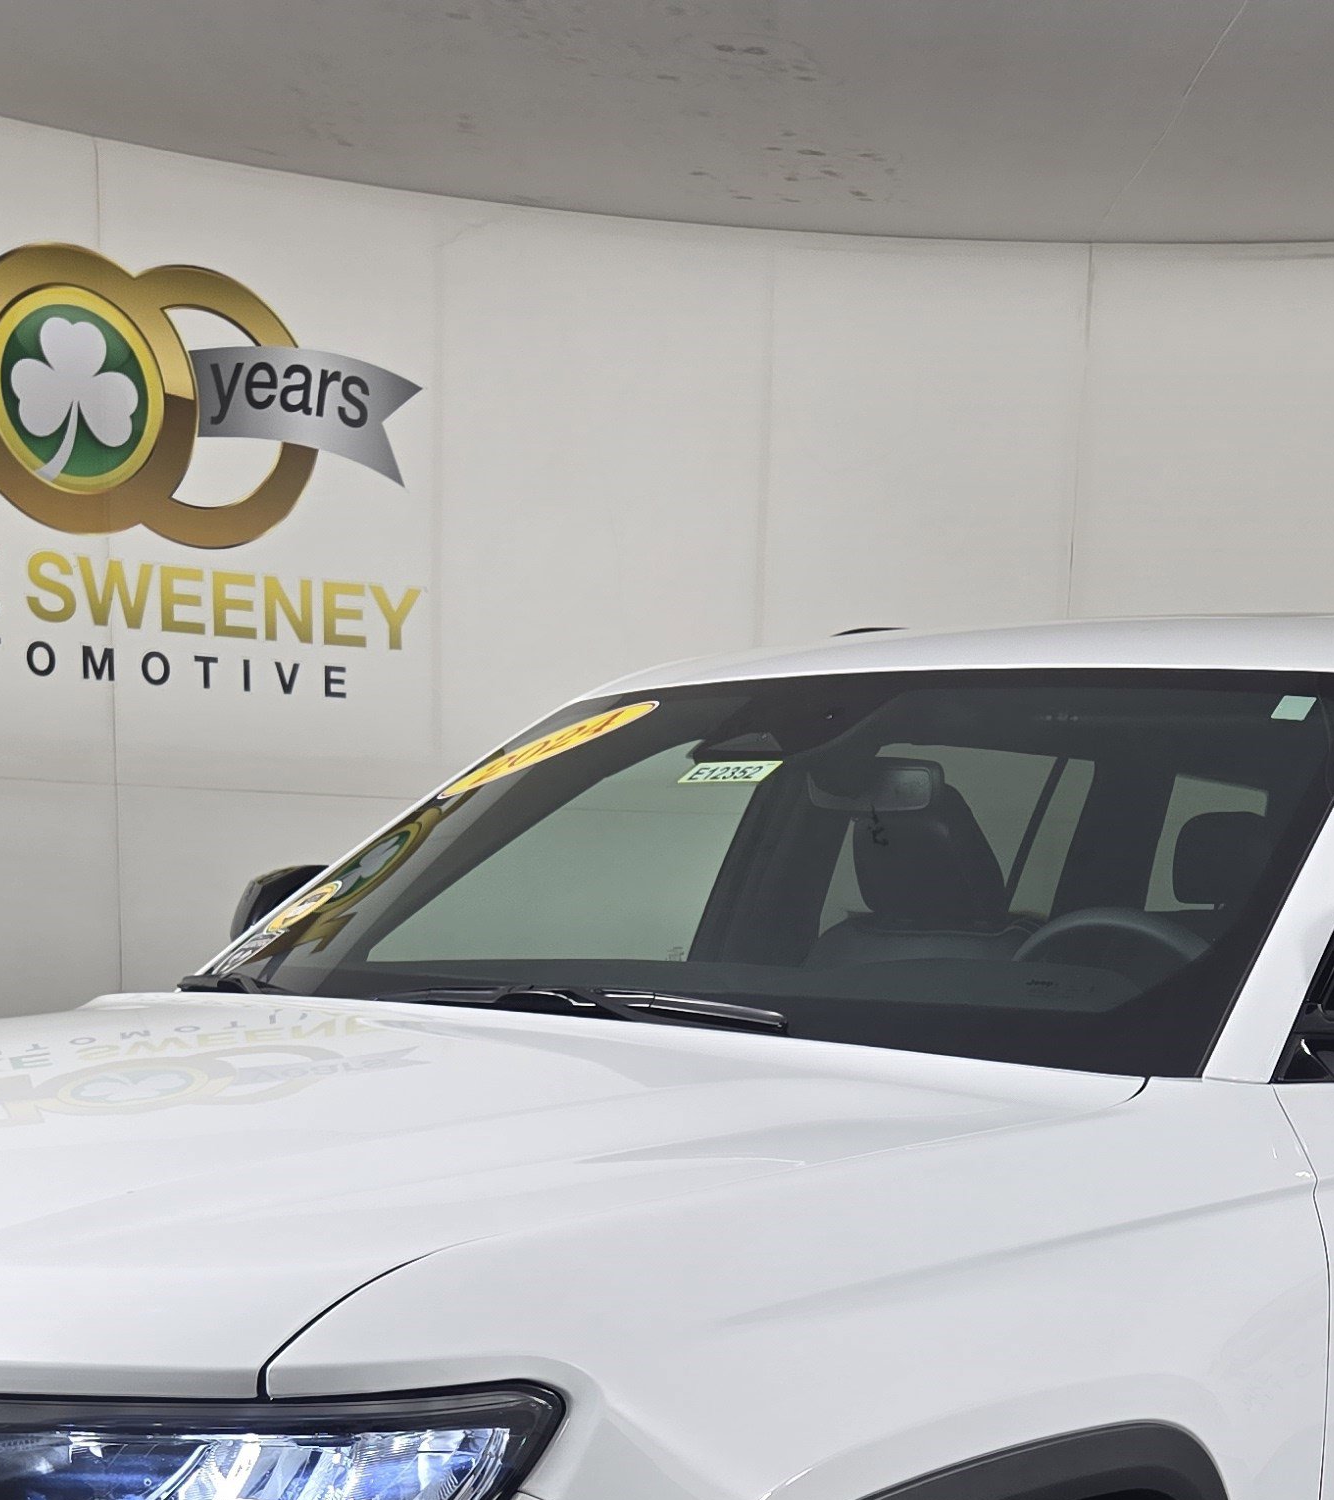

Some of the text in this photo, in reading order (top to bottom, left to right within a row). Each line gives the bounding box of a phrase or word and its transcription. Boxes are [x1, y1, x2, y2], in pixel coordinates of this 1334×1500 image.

[209, 360, 370, 429] years
[25, 550, 423, 651] SWEENEY
[470, 710, 625, 786] 2024
[687, 765, 764, 781] E12352
